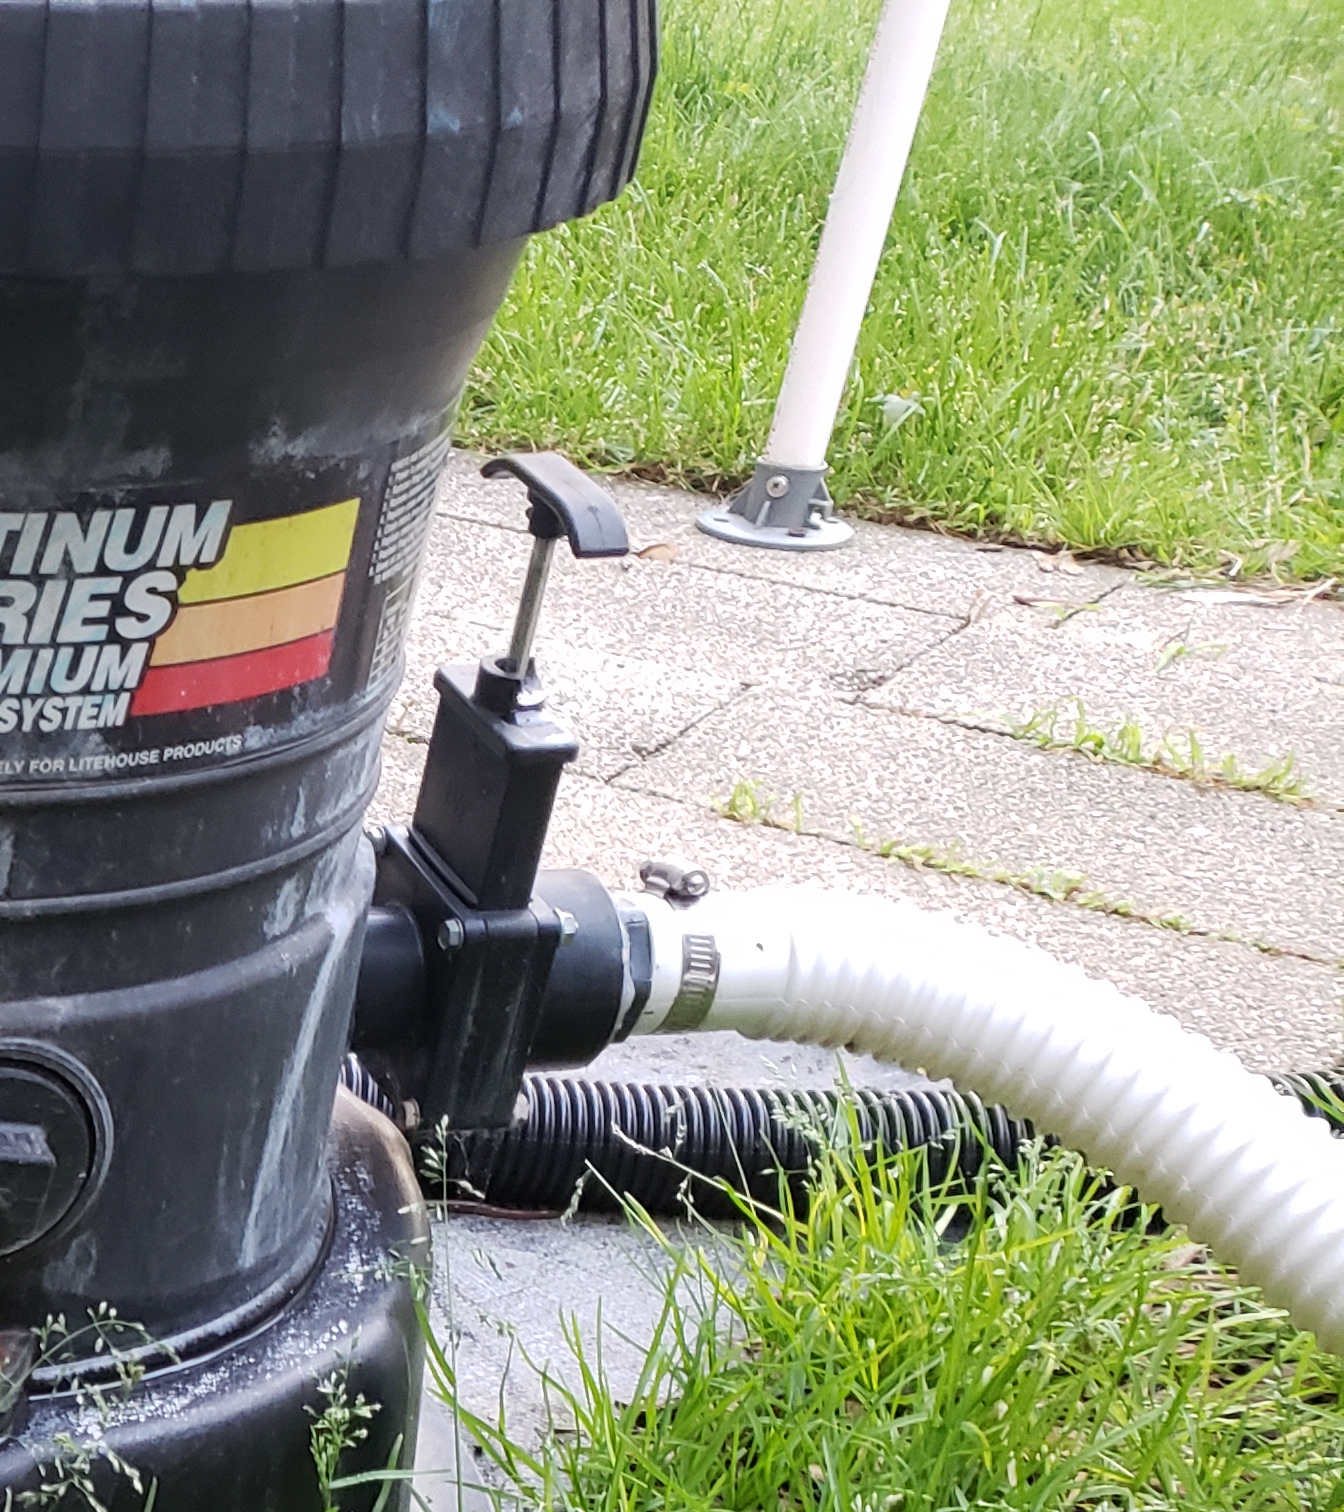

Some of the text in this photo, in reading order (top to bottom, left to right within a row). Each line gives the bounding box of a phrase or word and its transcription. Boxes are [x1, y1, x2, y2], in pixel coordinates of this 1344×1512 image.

[28, 759, 65, 774] FOR
[68, 749, 160, 773] LITEHOUSE
[162, 734, 243, 763] PRODUCTS
